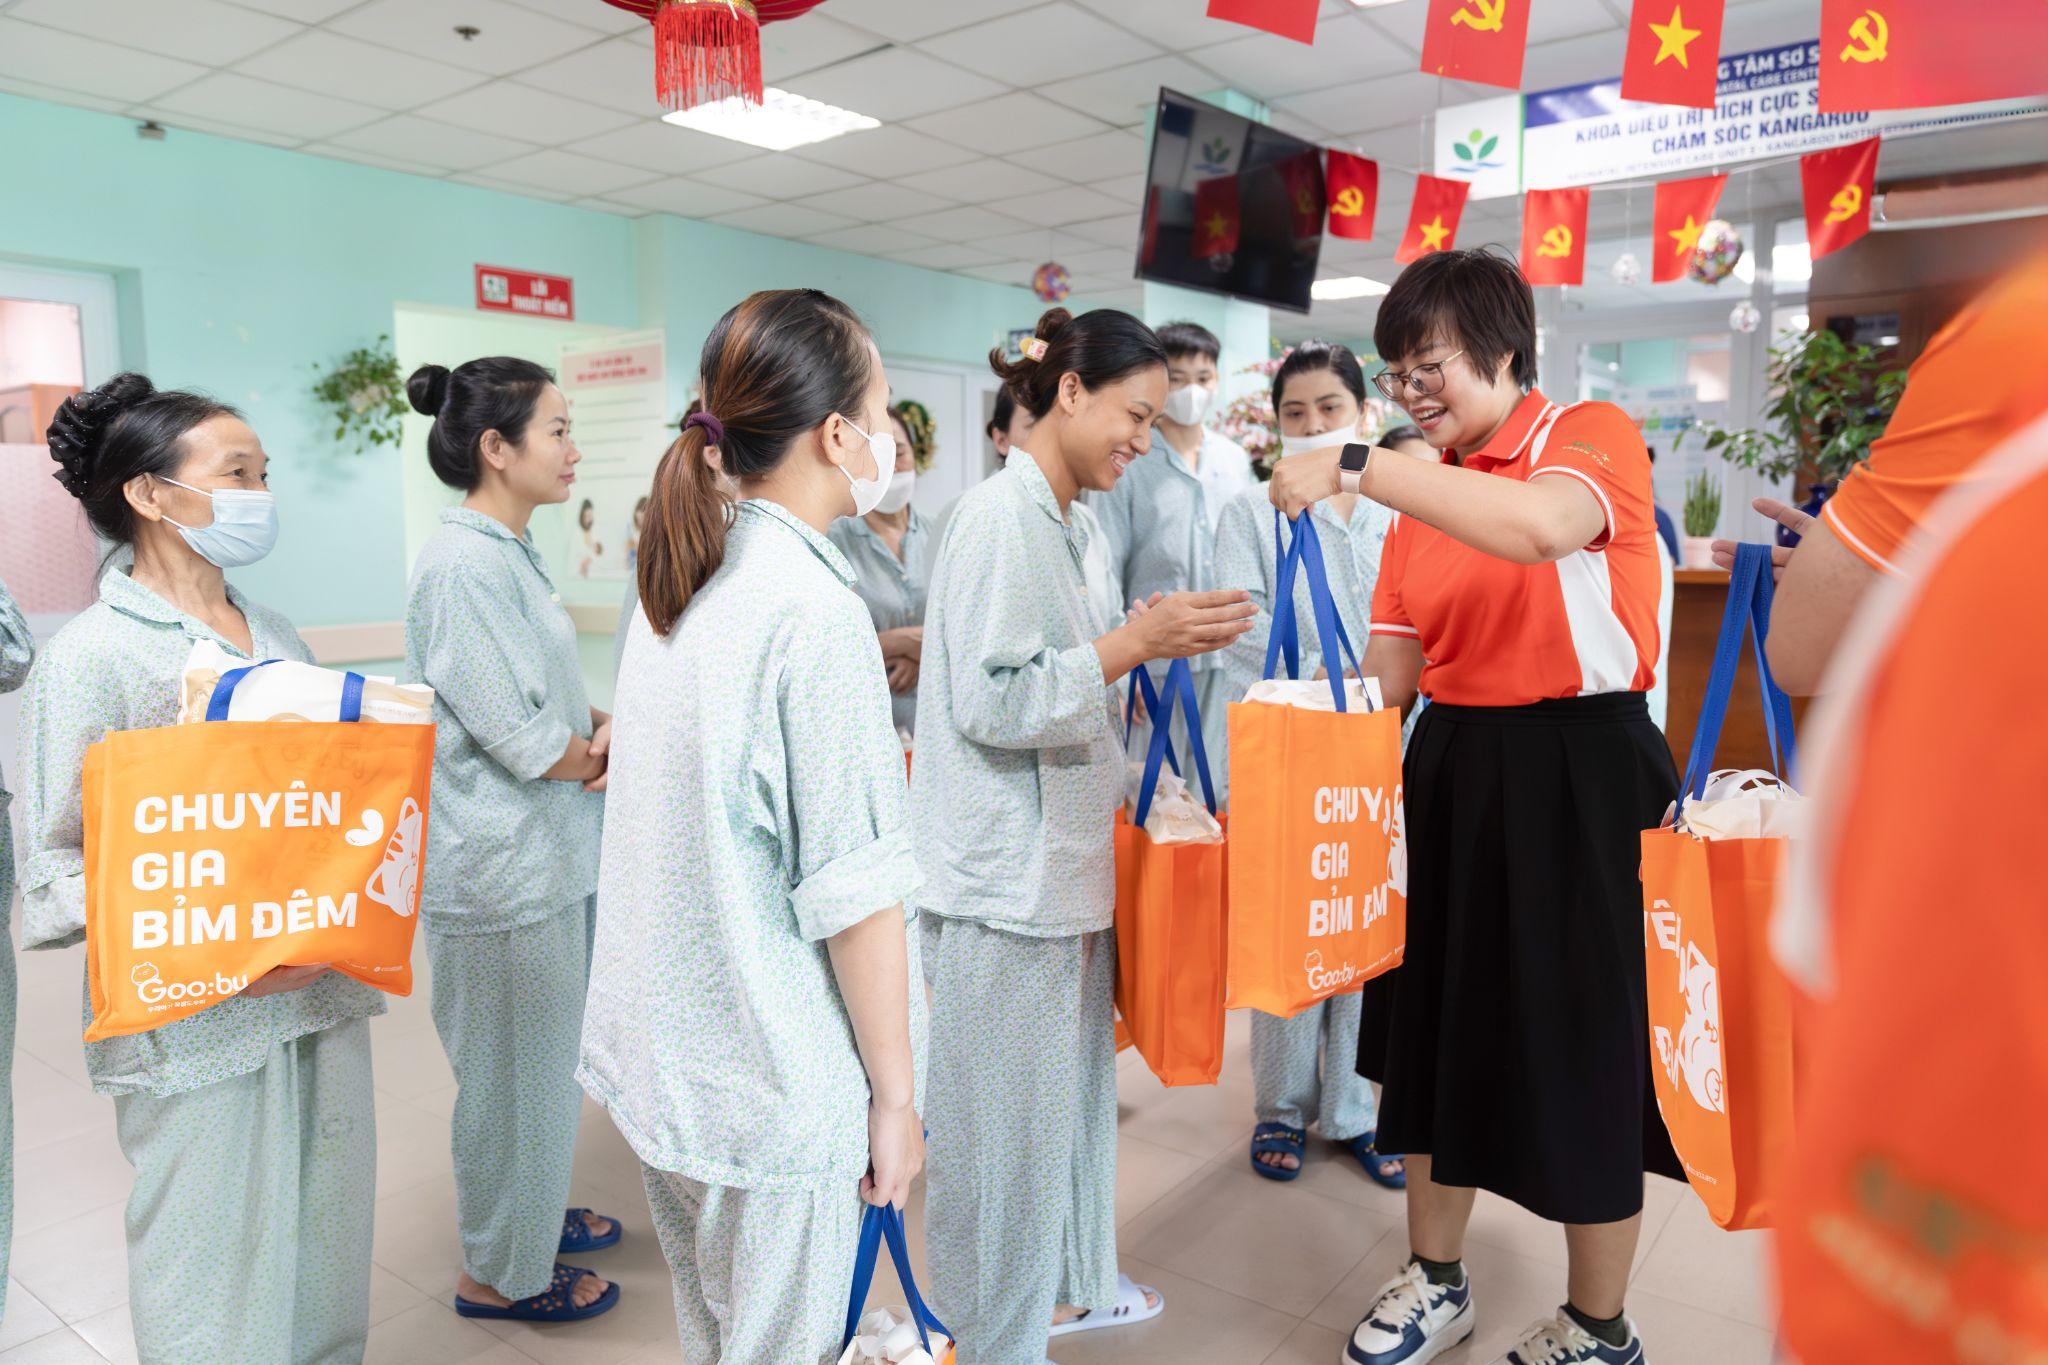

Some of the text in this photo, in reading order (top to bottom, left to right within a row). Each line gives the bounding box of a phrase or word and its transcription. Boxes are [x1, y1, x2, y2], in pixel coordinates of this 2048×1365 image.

[1759, 110, 1869, 137] KANGAROO
[134, 780, 341, 834] CHUYÊN
[132, 849, 226, 891] GIA
[1311, 842, 1349, 880] GIA
[132, 889, 358, 949] BỈM ĐÊM
[1308, 885, 1353, 937] BỈM
